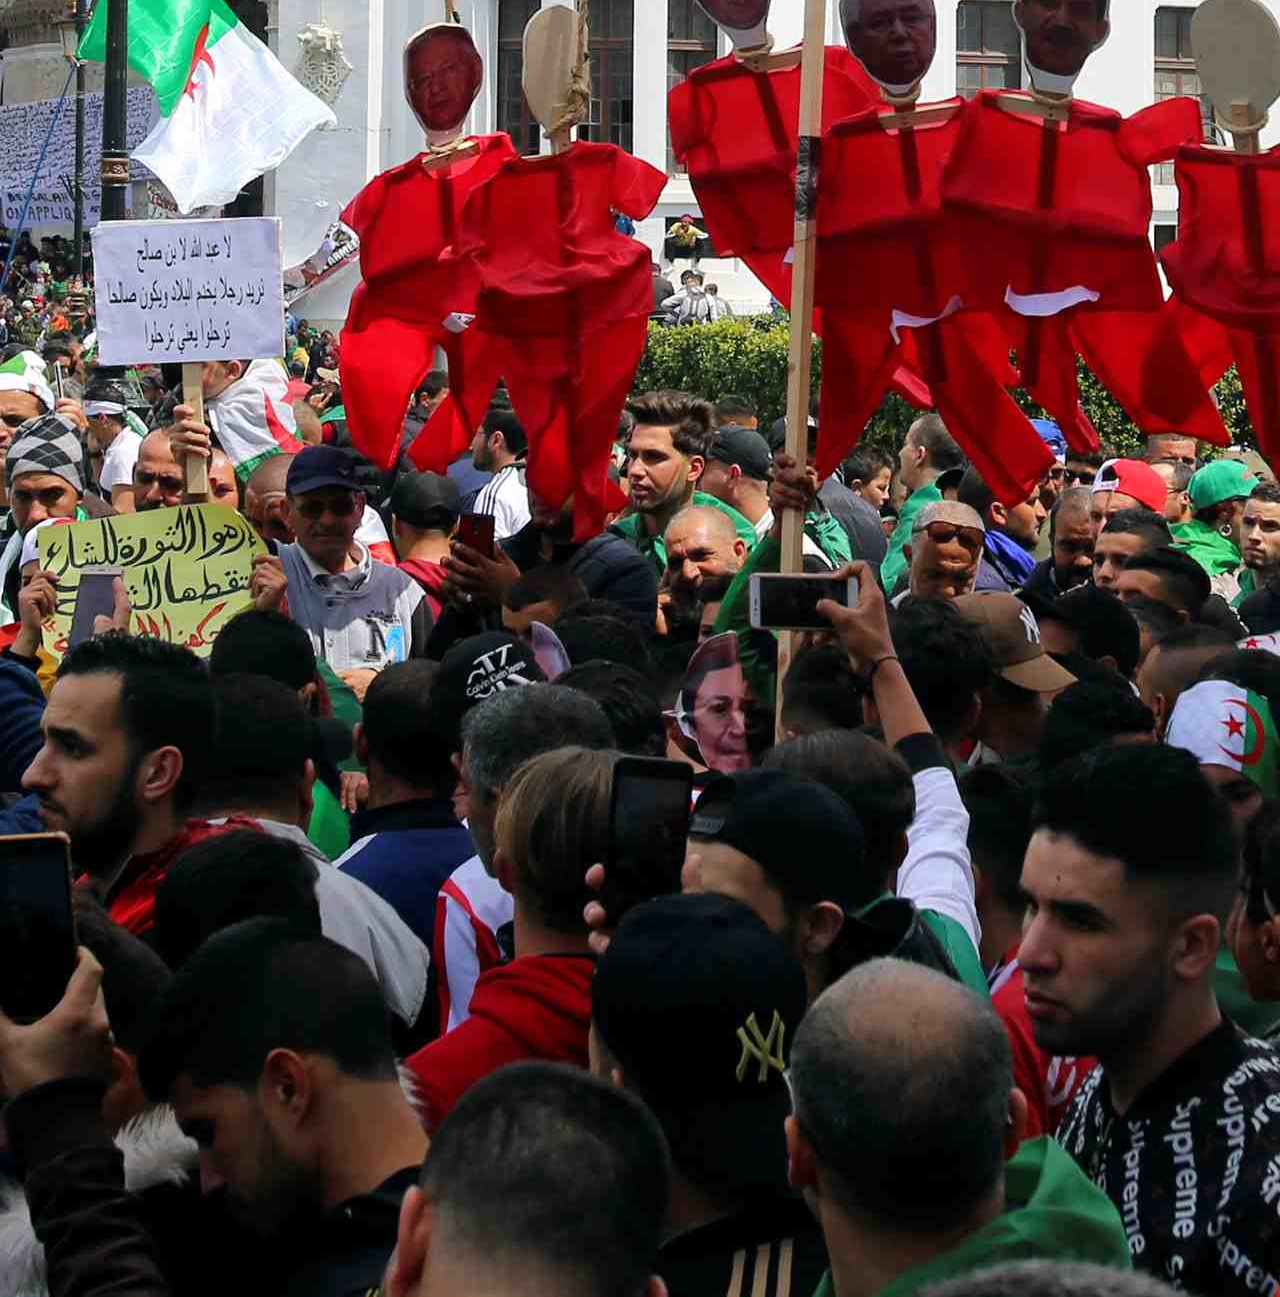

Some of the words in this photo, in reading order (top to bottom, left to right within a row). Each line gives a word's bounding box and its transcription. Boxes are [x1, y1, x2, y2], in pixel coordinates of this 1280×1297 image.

[136, 237, 162, 273] صالح
[165, 243, 177, 267] بن
[178, 237, 187, 261] لا
[190, 235, 202, 258] الله
[205, 241, 220, 264] عبد
[223, 234, 232, 259] لا
[106, 280, 137, 304] صالحا
[139, 279, 169, 310] ويكون
[171, 277, 193, 306] البلاد
[195, 280, 218, 309] يخدم
[220, 277, 244, 306] رجلا
[246, 277, 265, 305] نريد
[176, 322, 199, 354] يعني
[466, 678, 490, 697] Calvin
[736, 1008, 785, 1083] NY
[1164, 1097, 1201, 1239] Supreme
